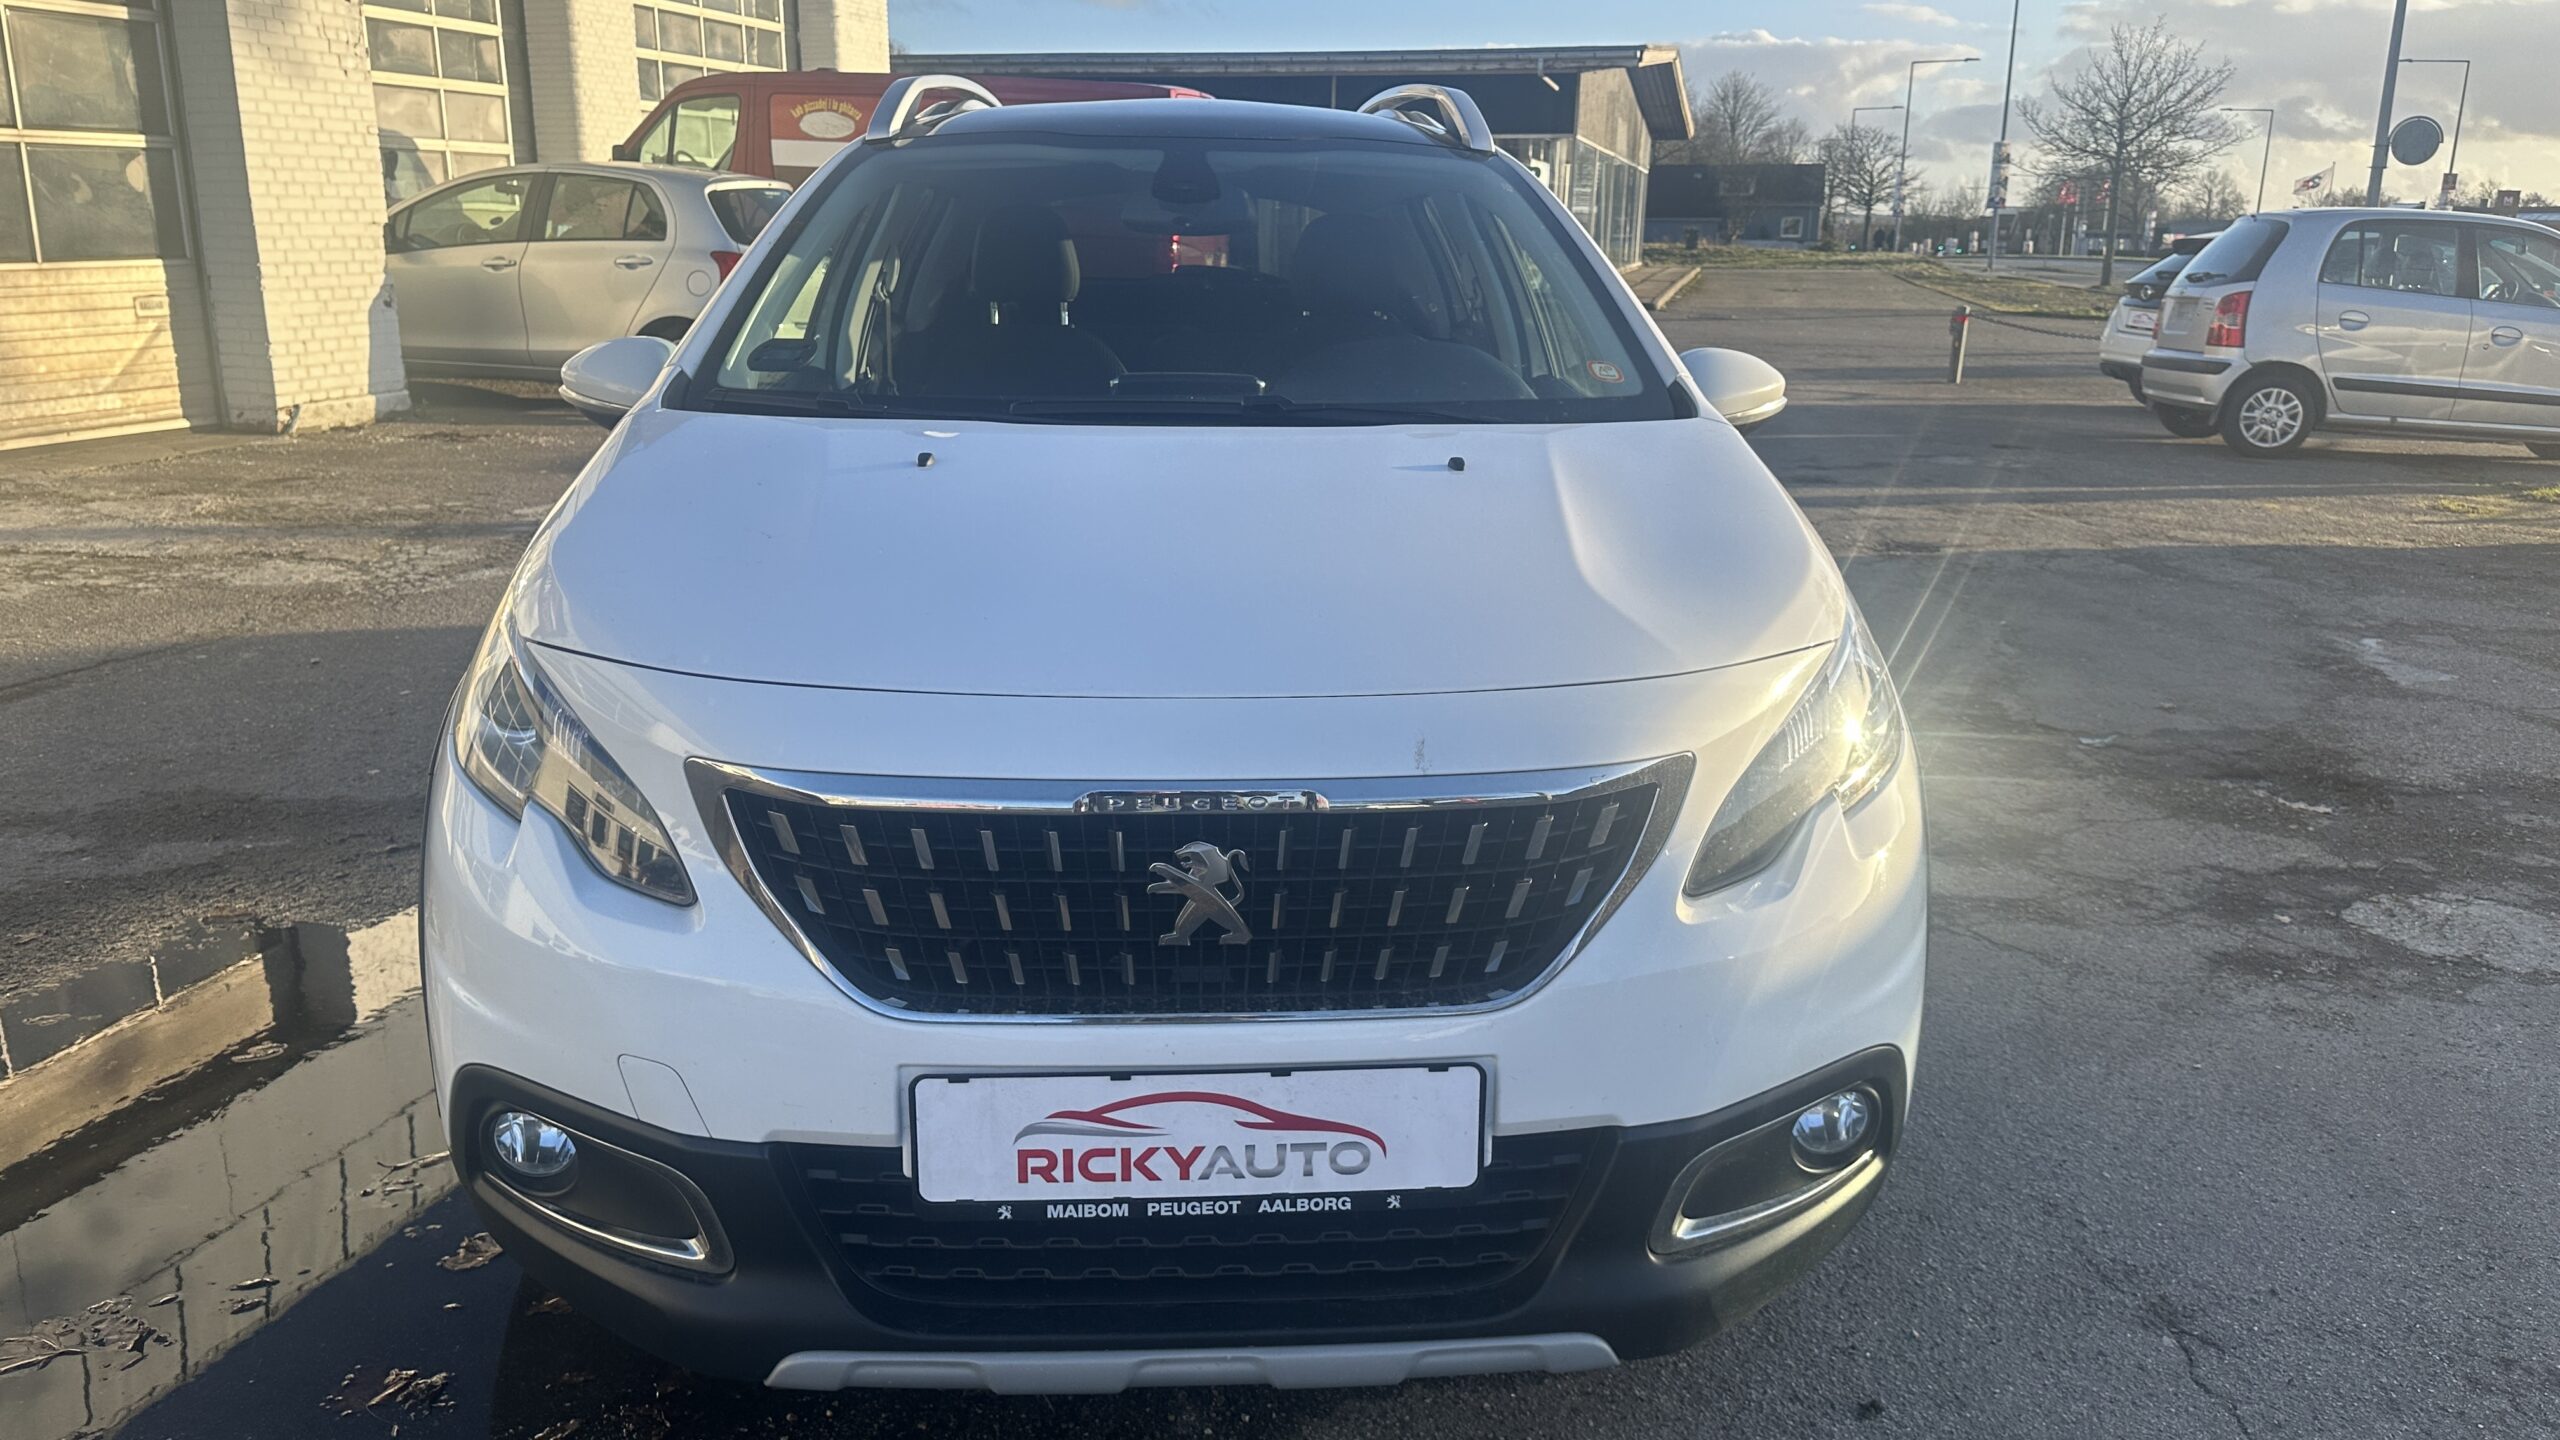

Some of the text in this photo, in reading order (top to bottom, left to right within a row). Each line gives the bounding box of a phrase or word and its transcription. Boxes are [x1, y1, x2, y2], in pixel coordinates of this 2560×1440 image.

[1105, 795, 1296, 811] PEUGEOT
[1047, 1197, 1352, 1219] MAIBOM PEUGEOT AALBORG
